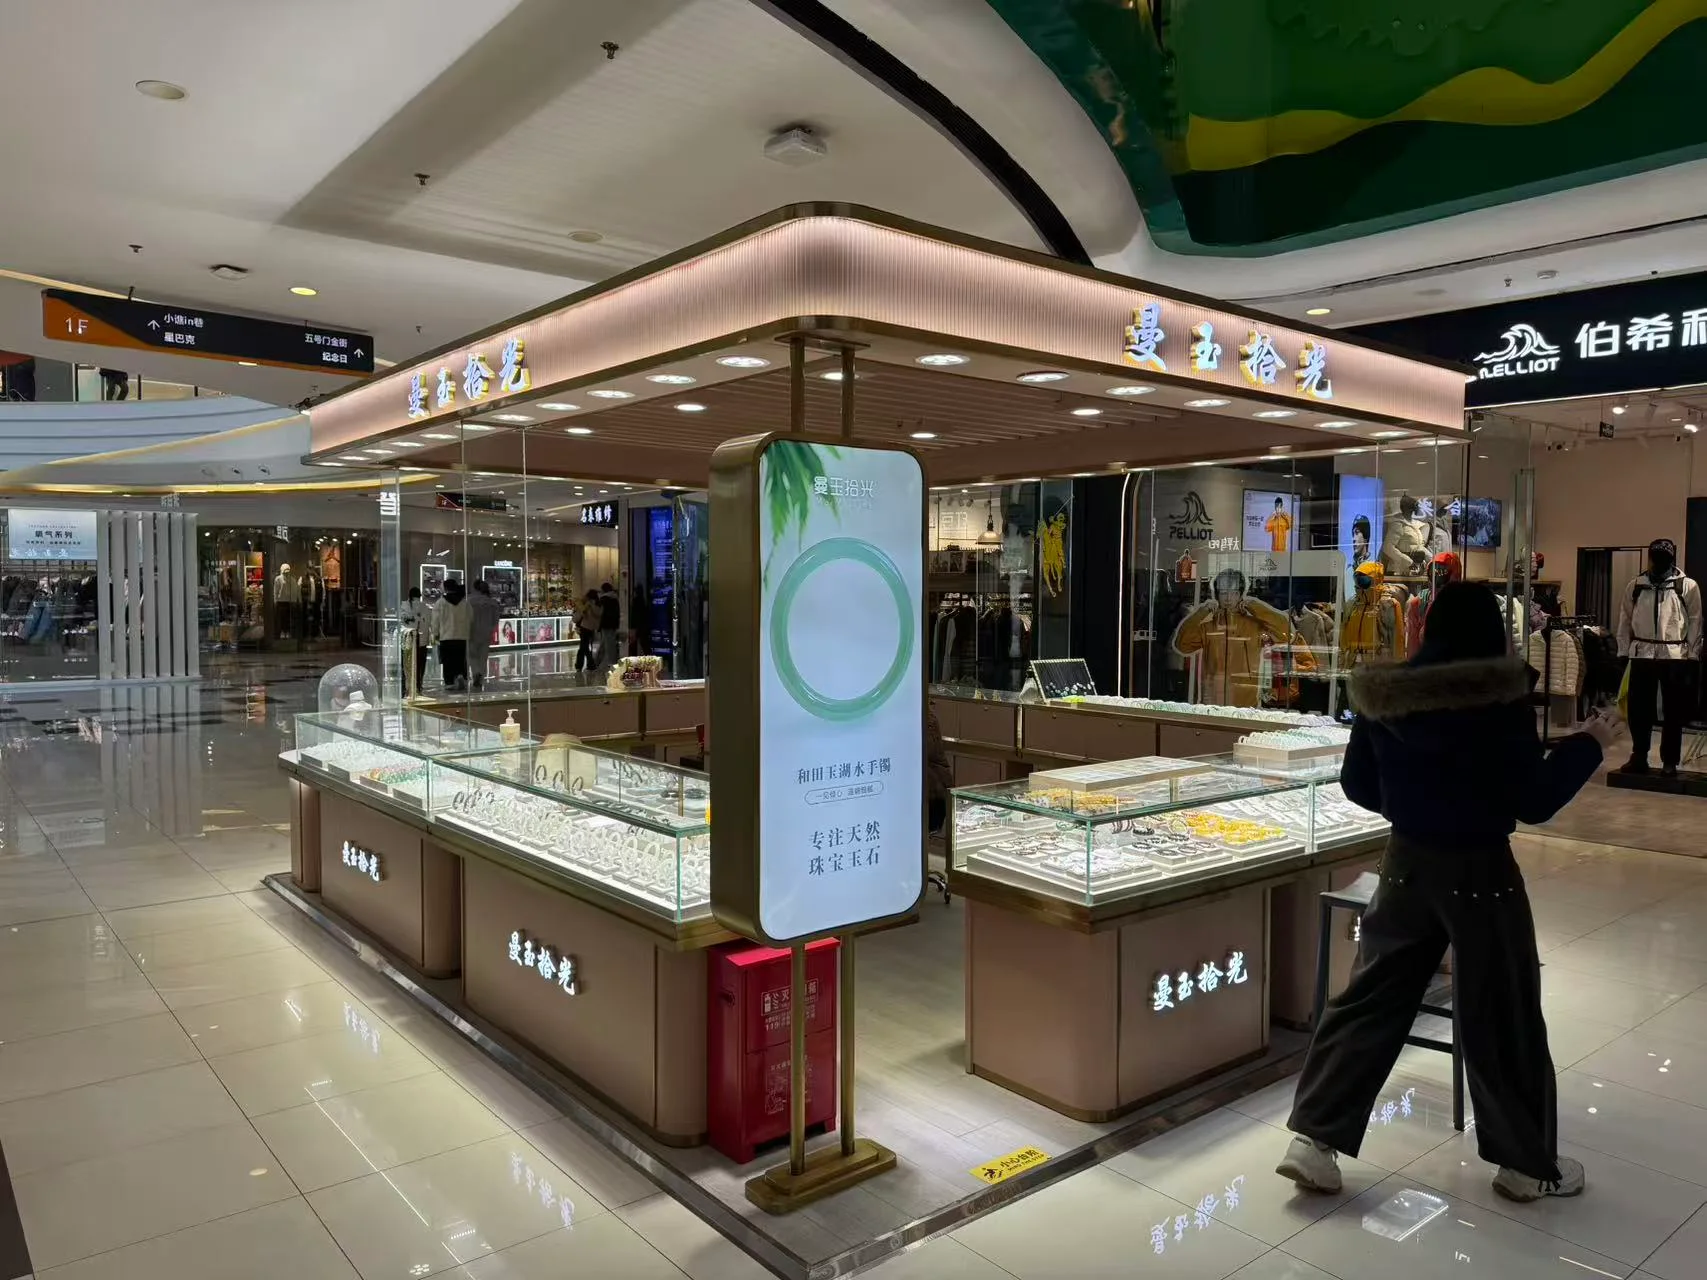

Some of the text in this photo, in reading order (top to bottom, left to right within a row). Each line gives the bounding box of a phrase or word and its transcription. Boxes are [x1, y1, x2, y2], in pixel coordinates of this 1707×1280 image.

[65, 316, 89, 335] 1F
[163, 331, 196, 345] 星巴克
[322, 351, 348, 364] 纪念日
[1124, 302, 1334, 399] 曼玉拾光
[407, 336, 532, 420] 曼玉拾光
[1169, 526, 1213, 540] PELLIOT
[797, 757, 891, 785] 和田玉湖水手镯
[809, 820, 880, 851] 专注天然
[808, 845, 881, 876] 珠宝玉石
[508, 930, 577, 996] 曼玉拾光
[1153, 951, 1248, 1012] 曼玉拾光
